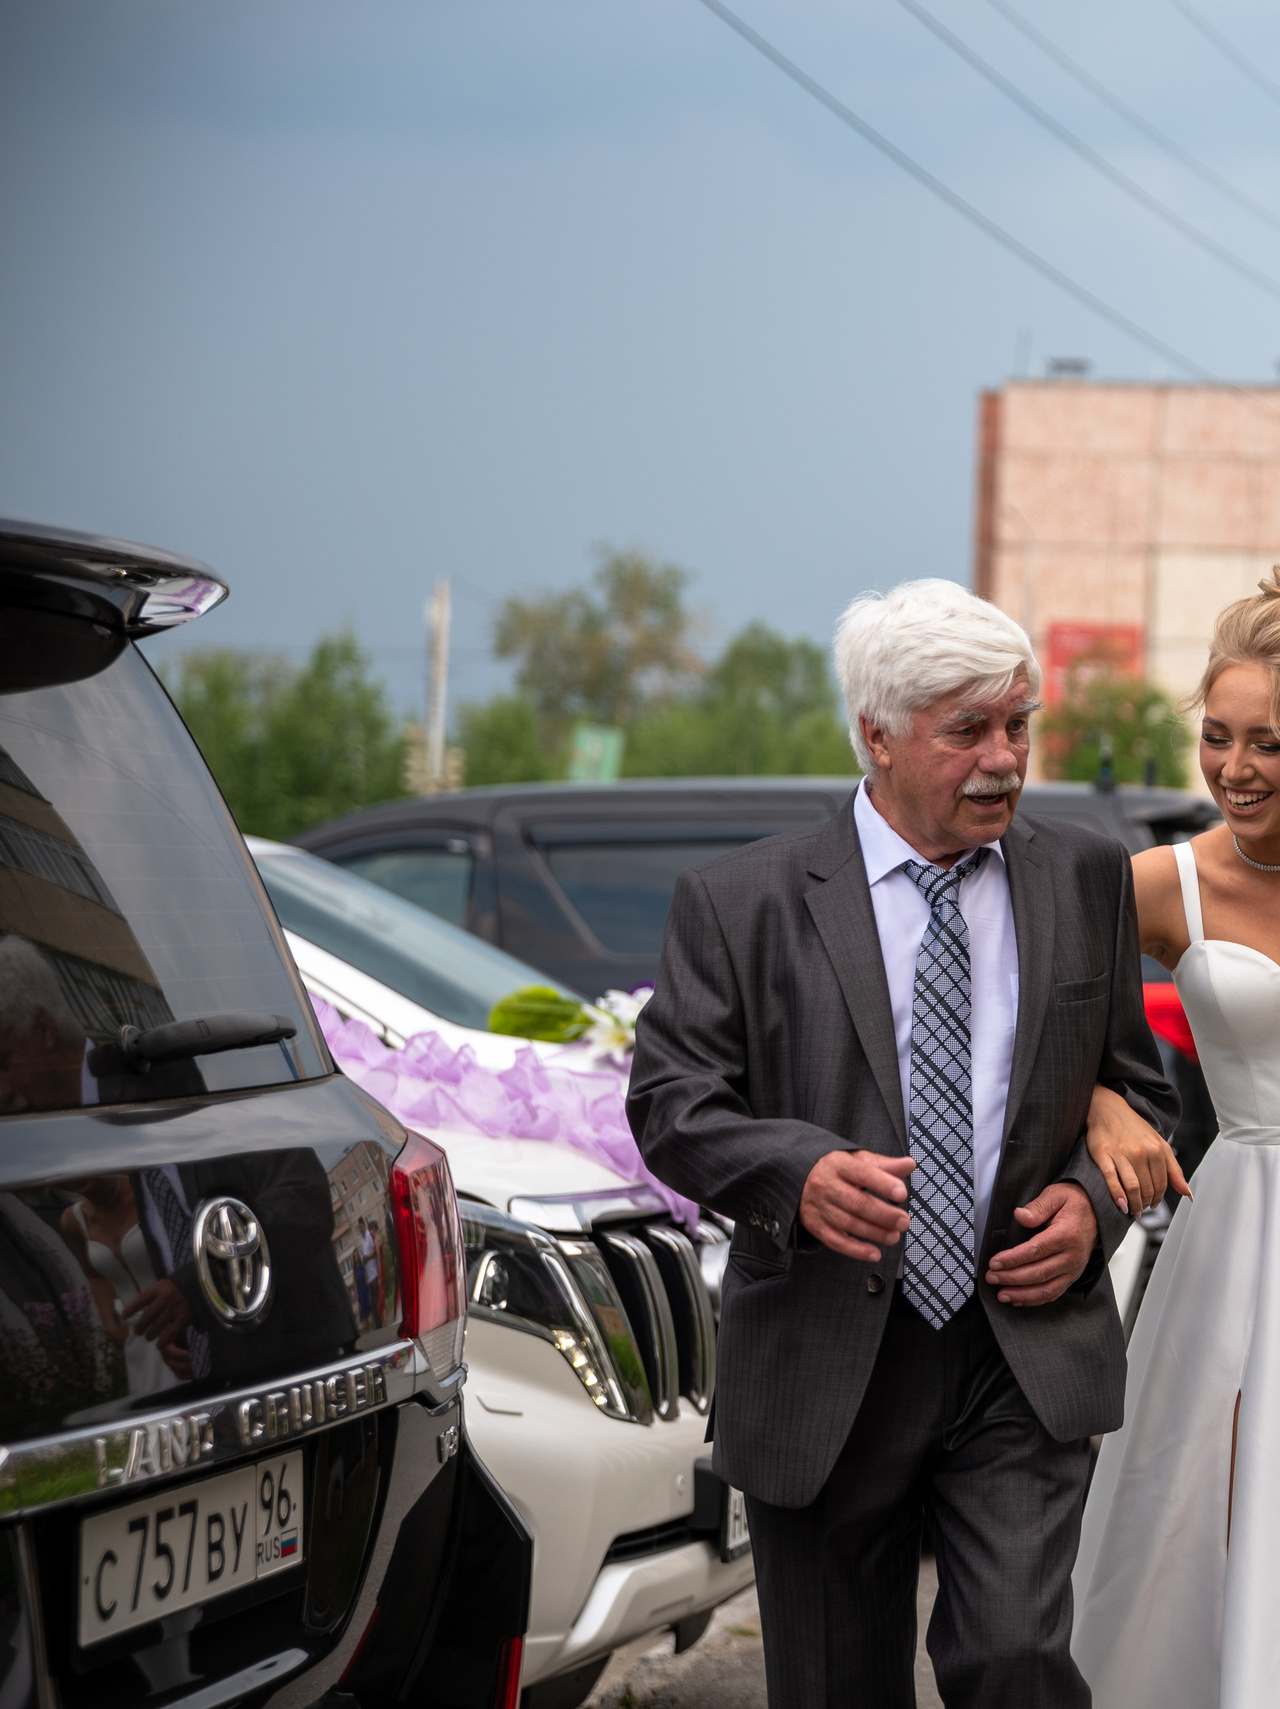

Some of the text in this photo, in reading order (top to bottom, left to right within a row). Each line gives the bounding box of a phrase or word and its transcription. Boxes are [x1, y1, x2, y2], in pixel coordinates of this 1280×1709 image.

[94, 1361, 388, 1488] LAND CRUISER
[257, 1535, 281, 1566] RUS
